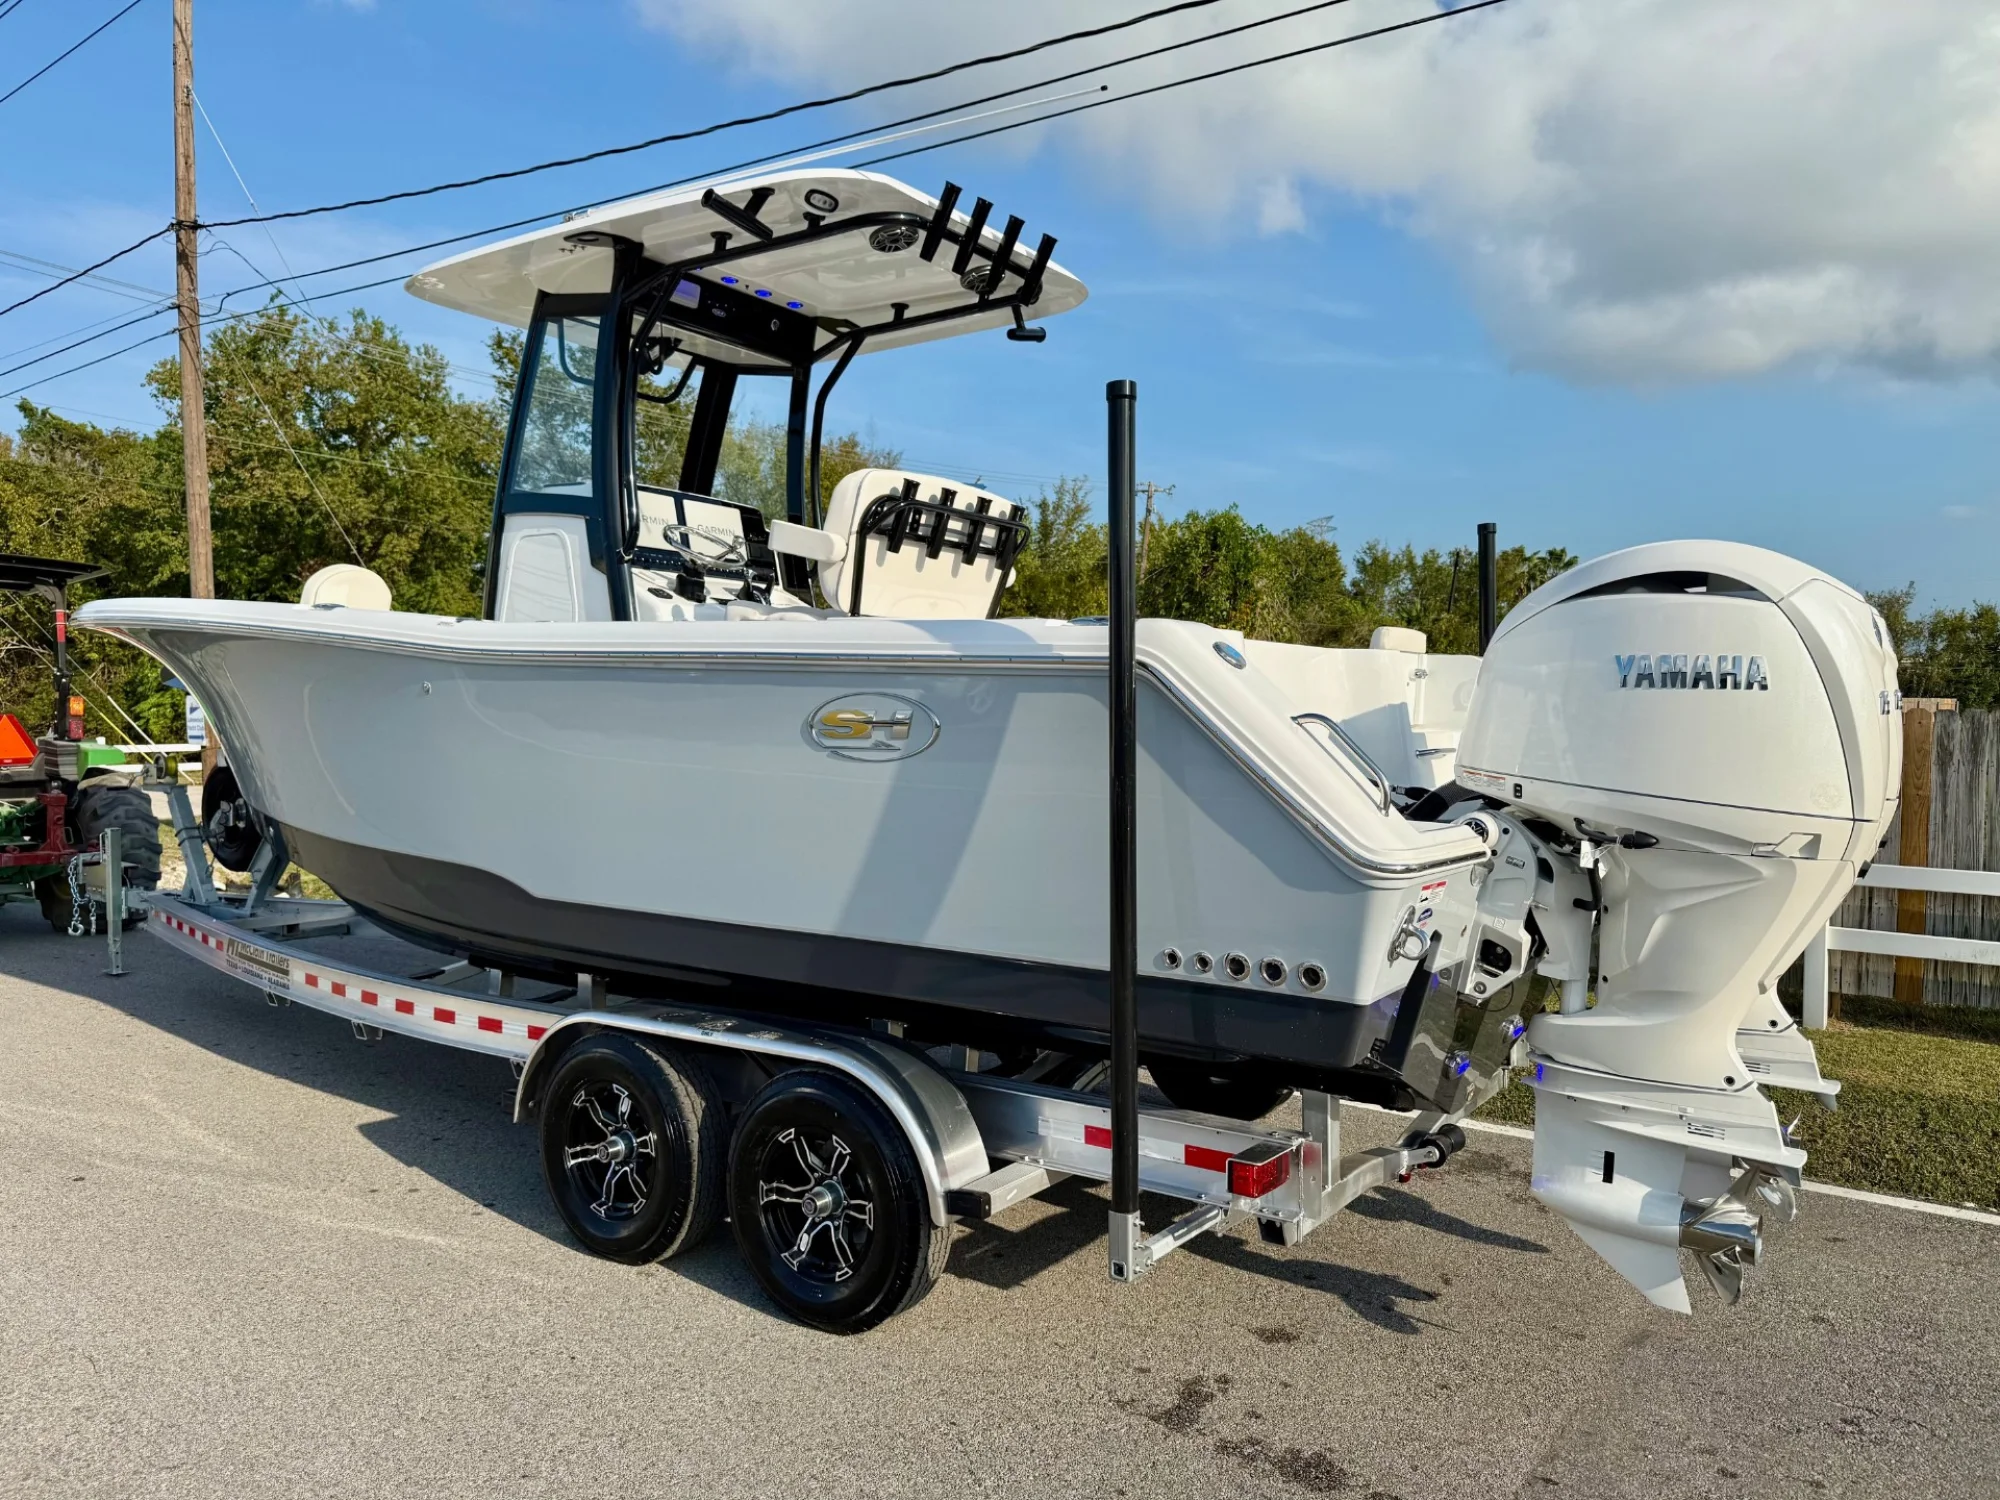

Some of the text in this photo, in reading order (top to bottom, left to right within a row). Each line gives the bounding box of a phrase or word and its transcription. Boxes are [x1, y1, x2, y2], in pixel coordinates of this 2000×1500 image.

[640, 514, 669, 526] RMIN
[697, 524, 735, 537] GARMIN
[1614, 654, 1770, 691] YAMAHA
[266, 950, 290, 969] Trailers
